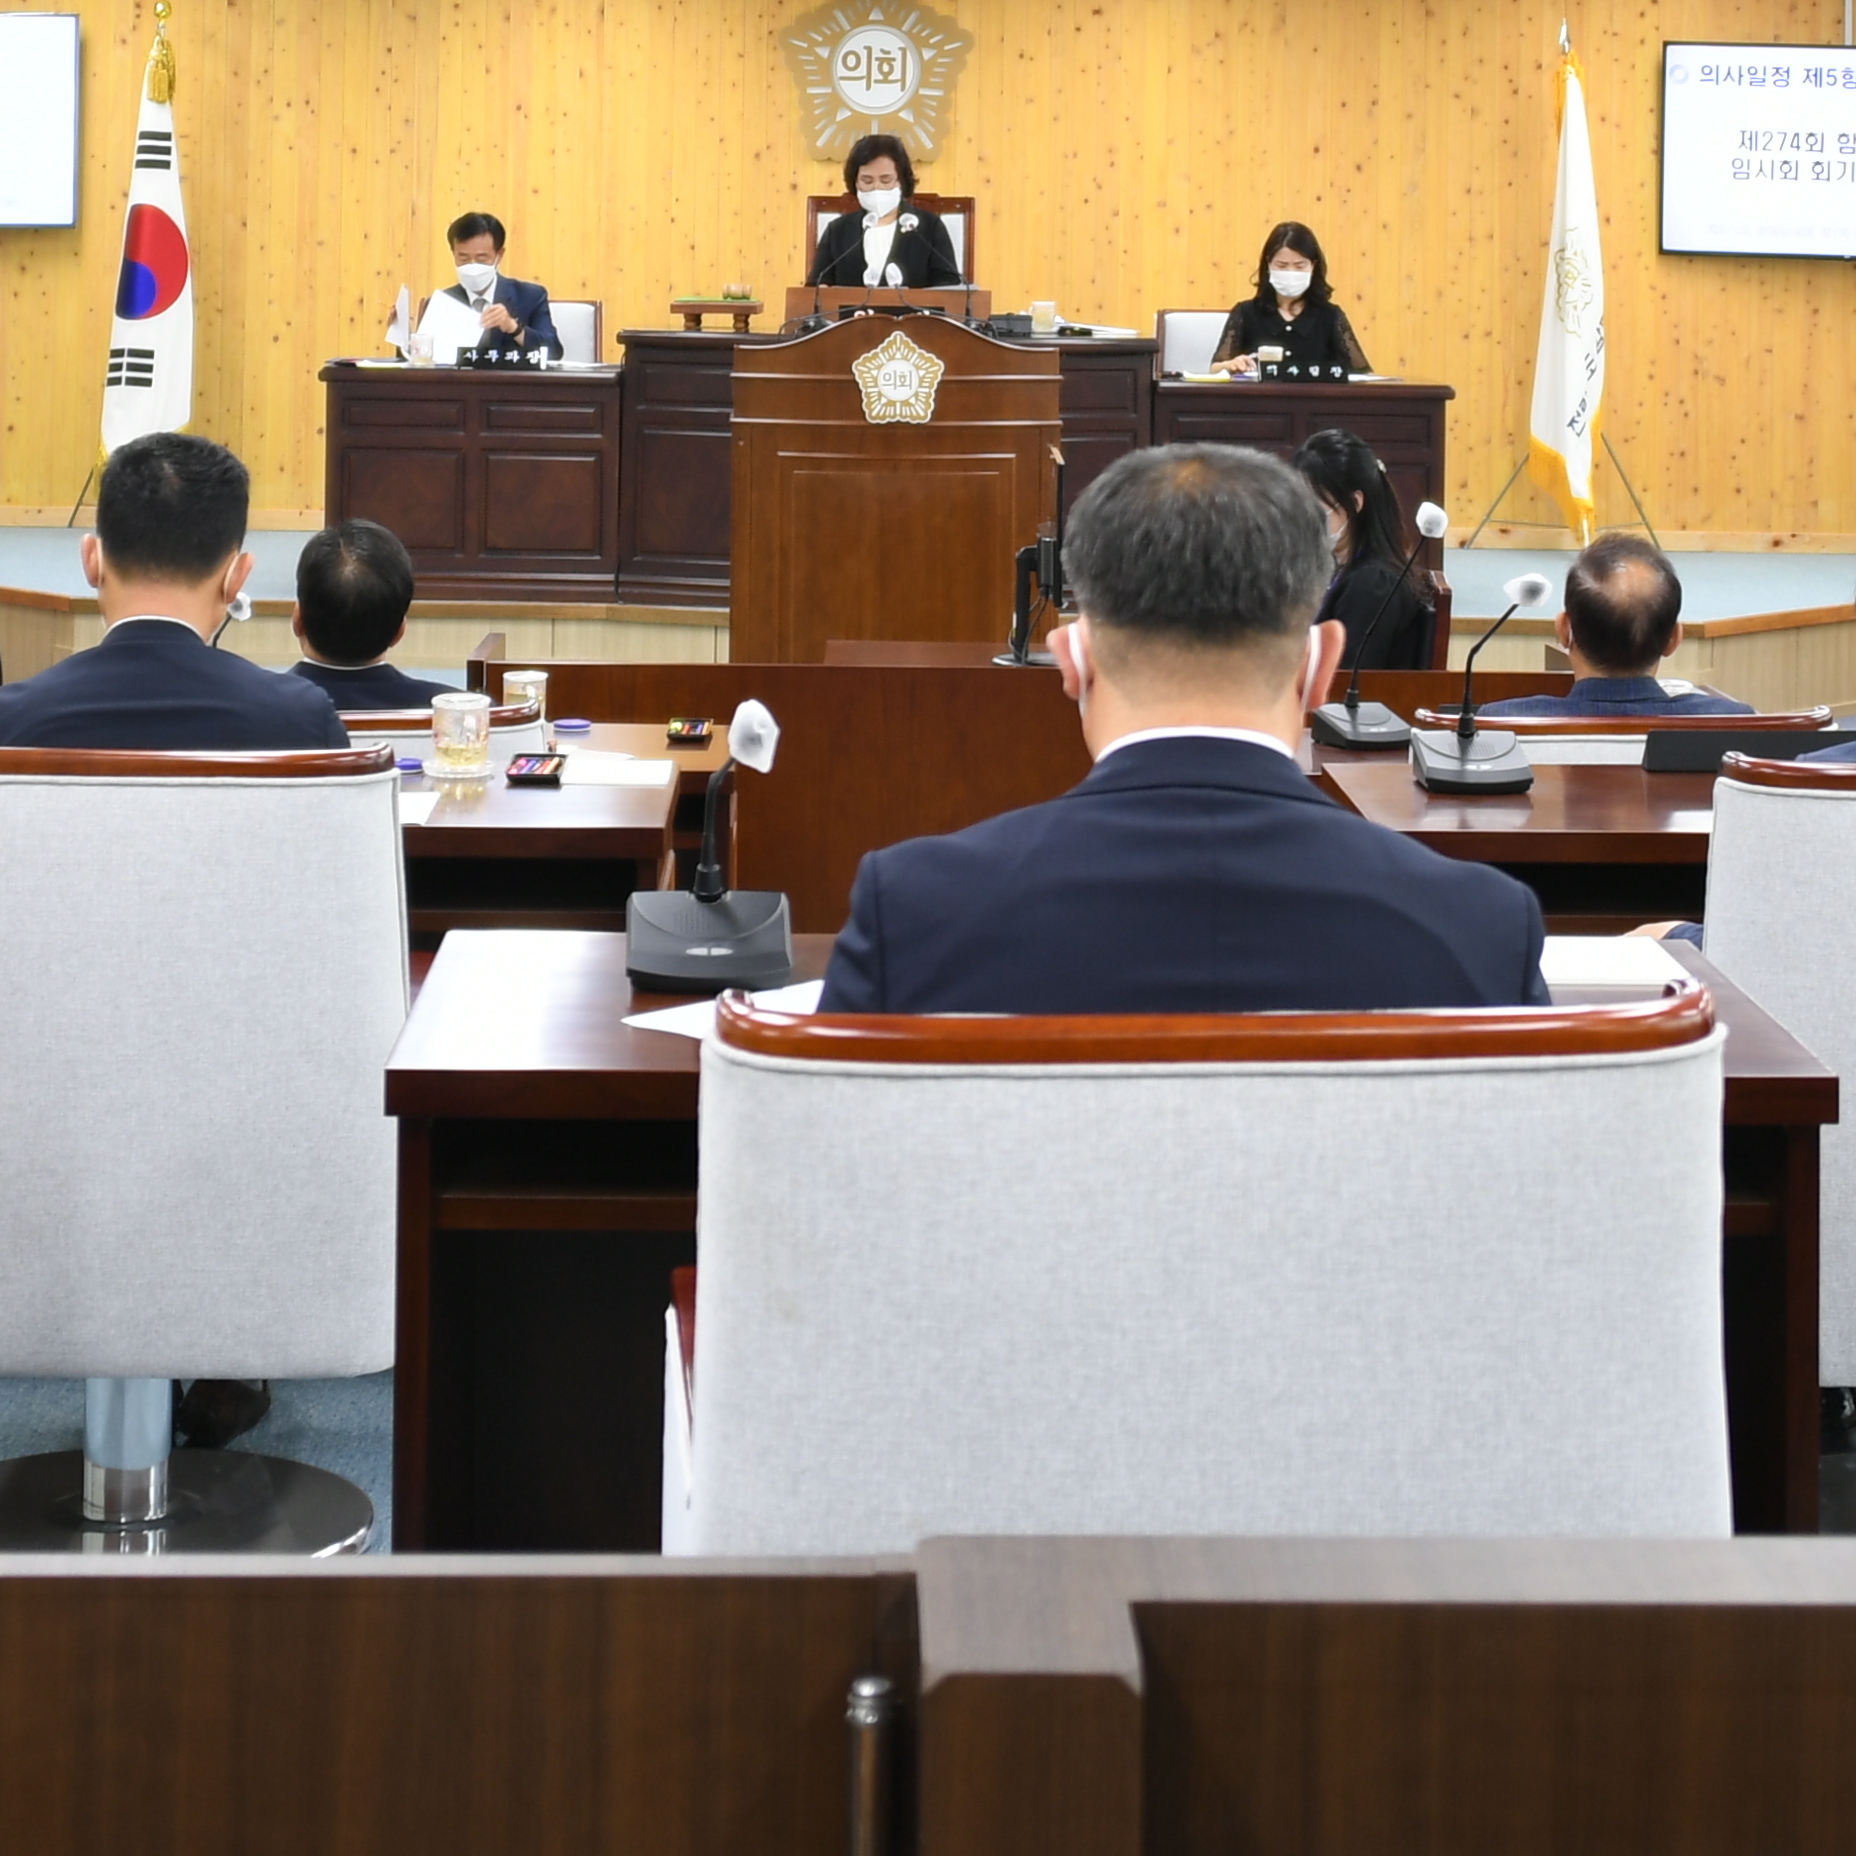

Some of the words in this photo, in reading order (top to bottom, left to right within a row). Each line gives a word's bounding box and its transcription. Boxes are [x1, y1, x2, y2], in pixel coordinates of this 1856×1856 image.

[838, 45, 908, 92] 의회
[1699, 64, 1792, 88] 의사일정
[1737, 129, 1827, 154] 제274회
[1731, 157, 1800, 182] 임시회
[881, 369, 913, 391] 의회
